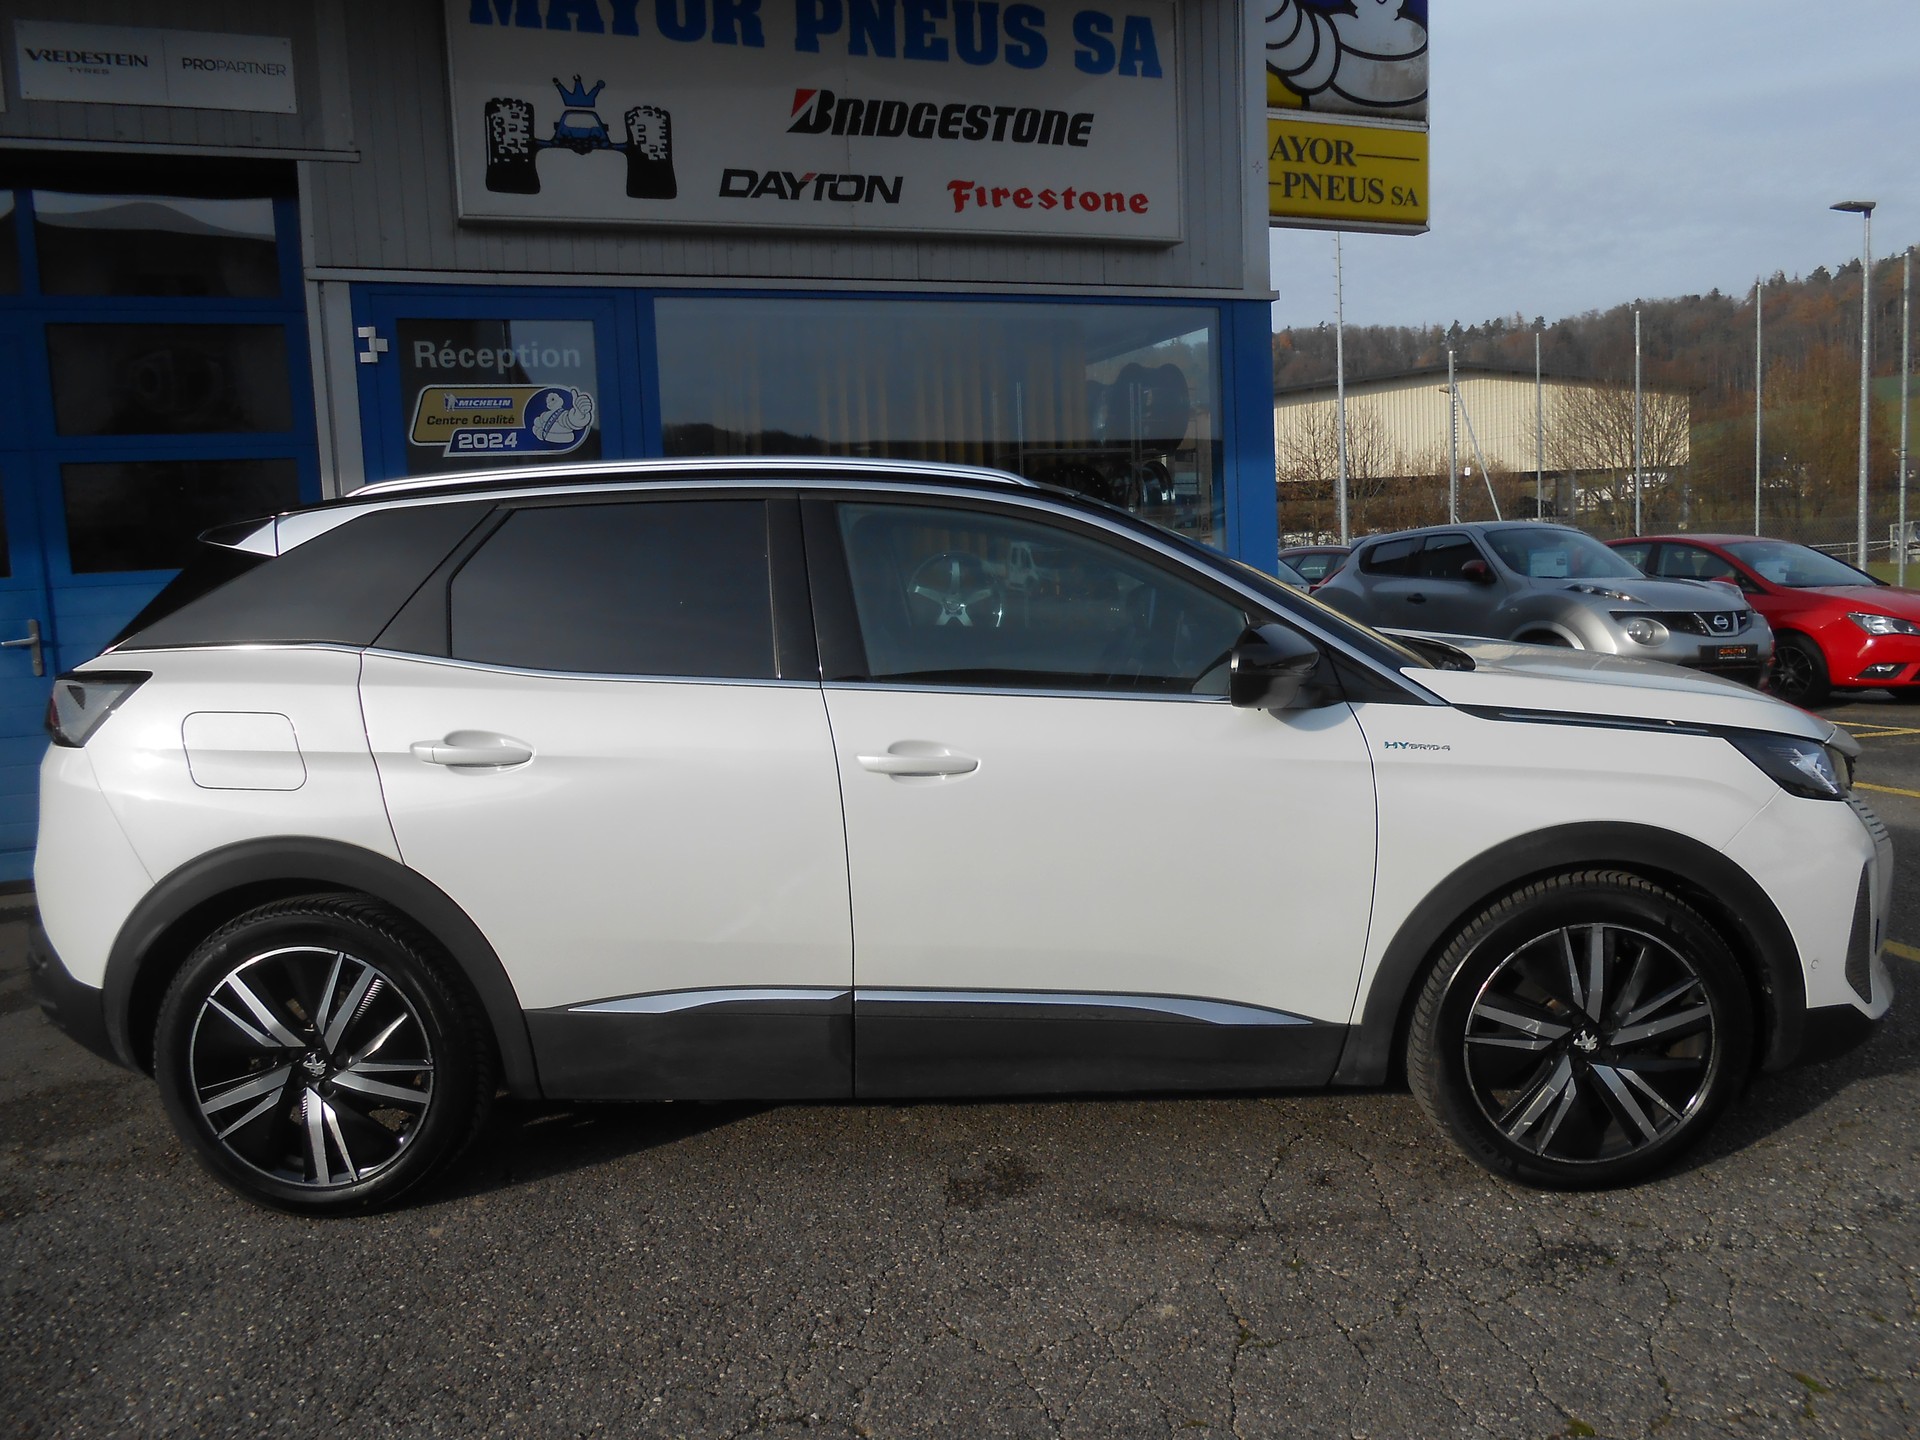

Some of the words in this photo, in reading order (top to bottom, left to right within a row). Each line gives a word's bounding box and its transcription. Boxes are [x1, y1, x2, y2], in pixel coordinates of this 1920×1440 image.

[794, 0, 1048, 69] PNEUS
[1073, 10, 1163, 78] SA
[25, 48, 148, 67] VREDESTEIN
[67, 66, 109, 75] TYRES
[182, 57, 286, 76] PROPARTNER
[786, 89, 1094, 147] BRIDGESTONE
[1269, 135, 1357, 167] AYOR
[719, 169, 903, 204] DAYTON
[947, 180, 1149, 214] Firestone
[1283, 171, 1384, 204] PNEUS
[1391, 186, 1419, 207] SA
[413, 340, 581, 374] Réception
[426, 415, 468, 425] Centre
[473, 413, 515, 425] Qualité
[457, 398, 512, 408] MICHELIN
[458, 432, 518, 448] 2024
